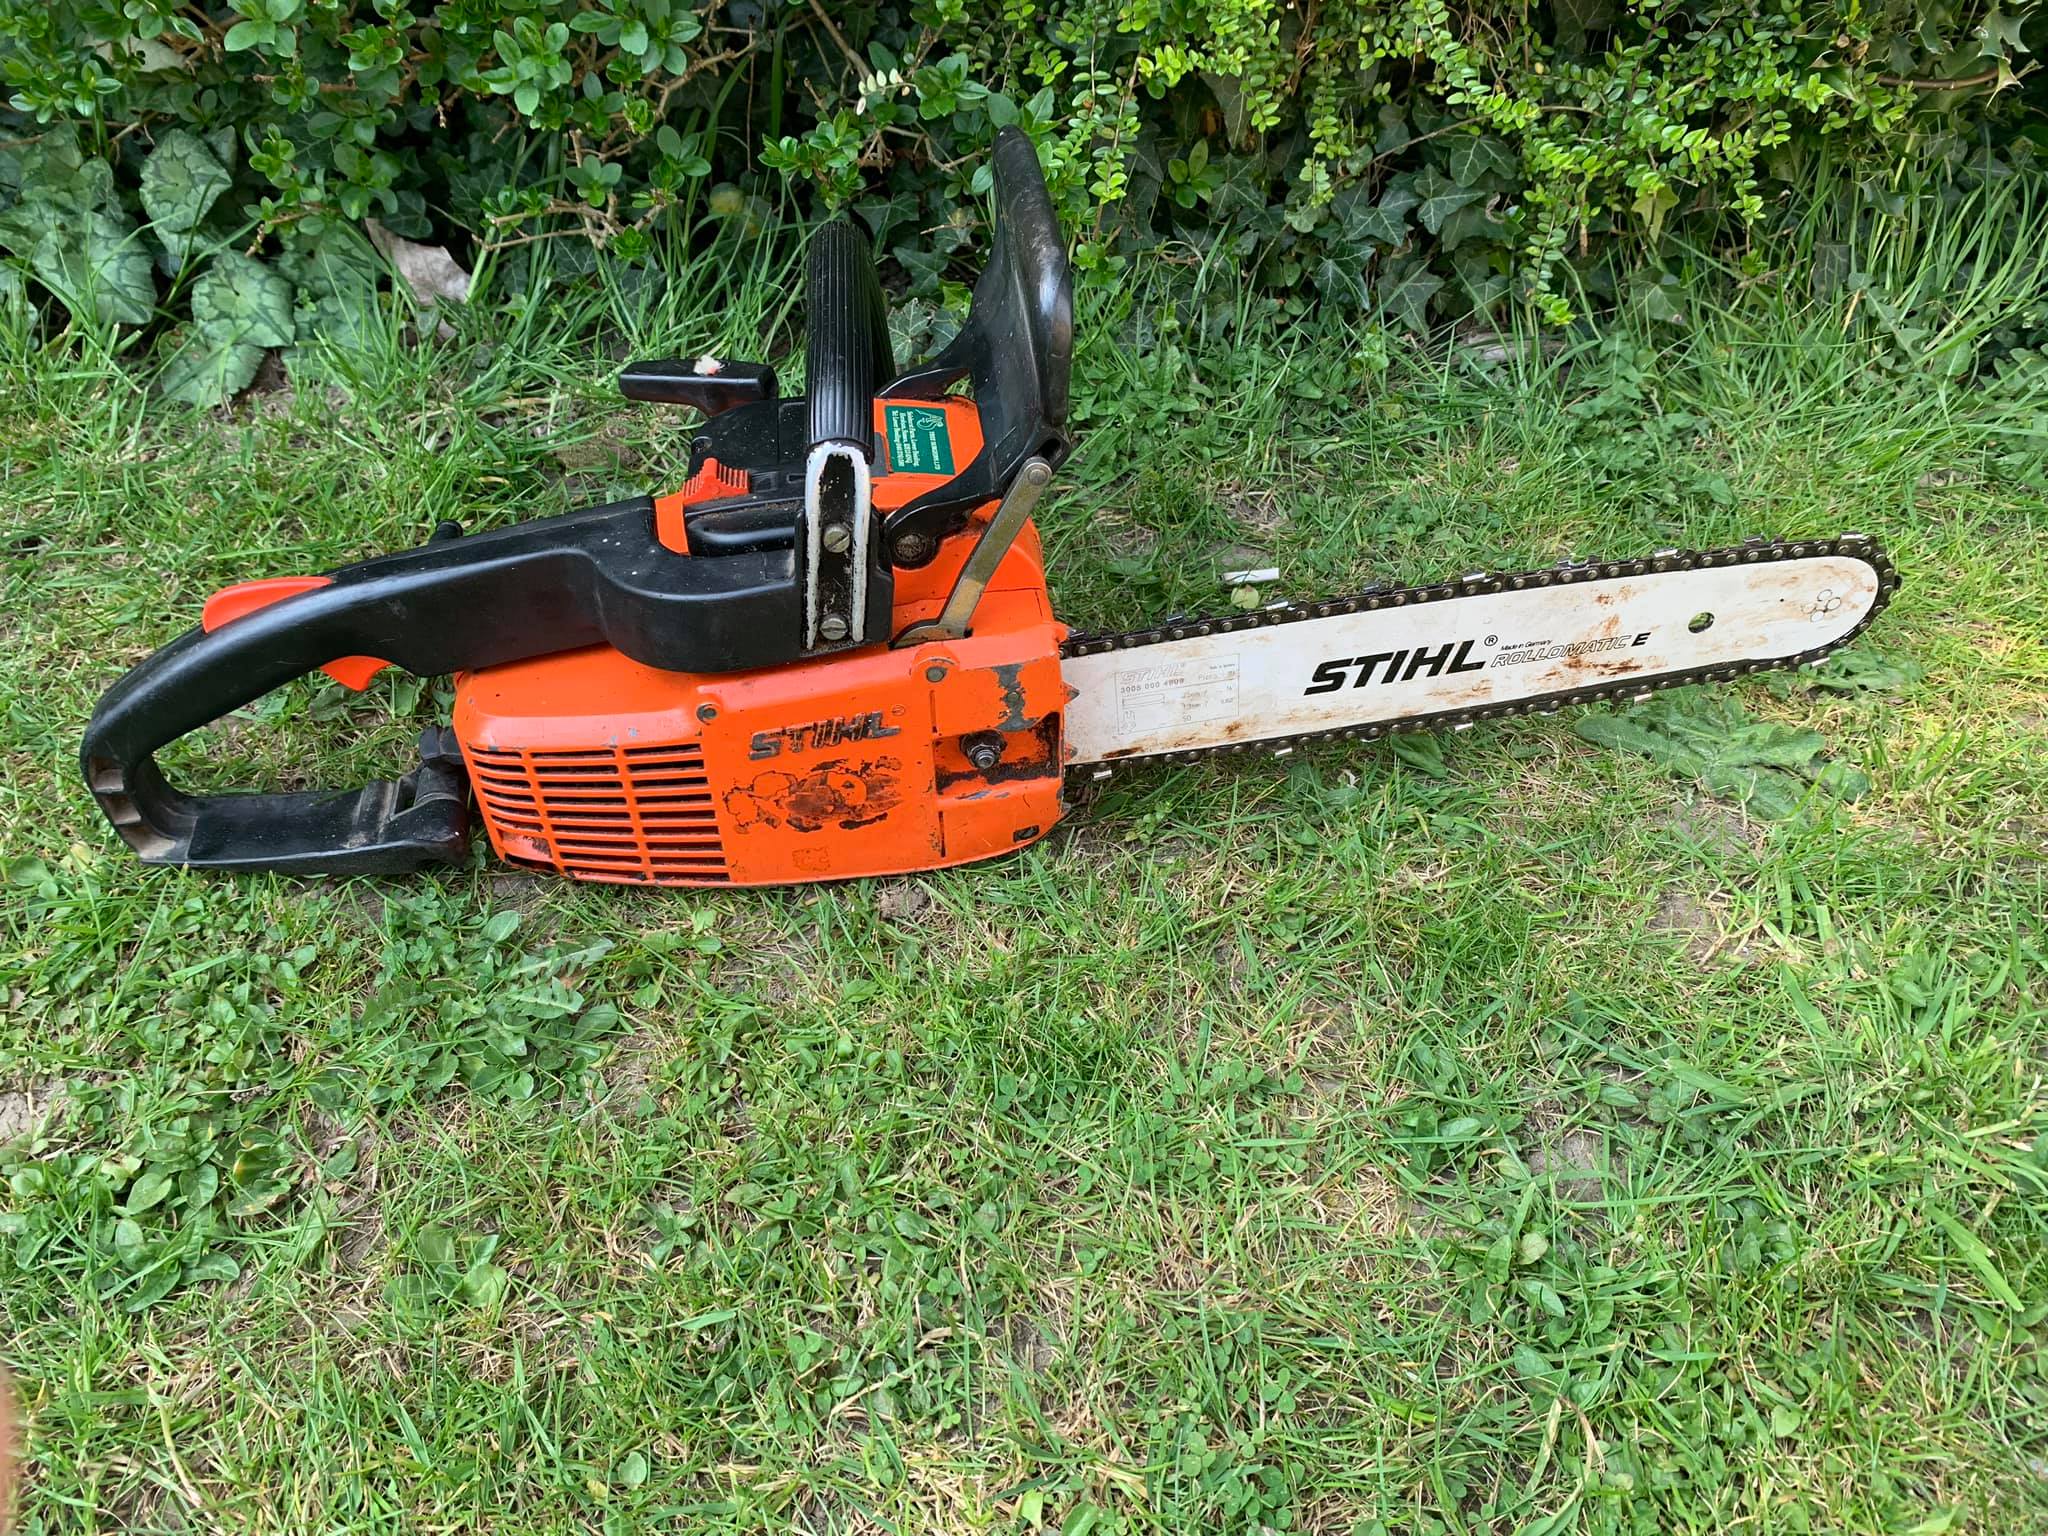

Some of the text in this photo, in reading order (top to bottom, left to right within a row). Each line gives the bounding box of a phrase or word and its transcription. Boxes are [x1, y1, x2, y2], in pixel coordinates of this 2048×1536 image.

[1303, 640, 1486, 696] STIHL
[1490, 632, 1652, 668] ROLLOMATIC E
[749, 710, 901, 760] STIHL
